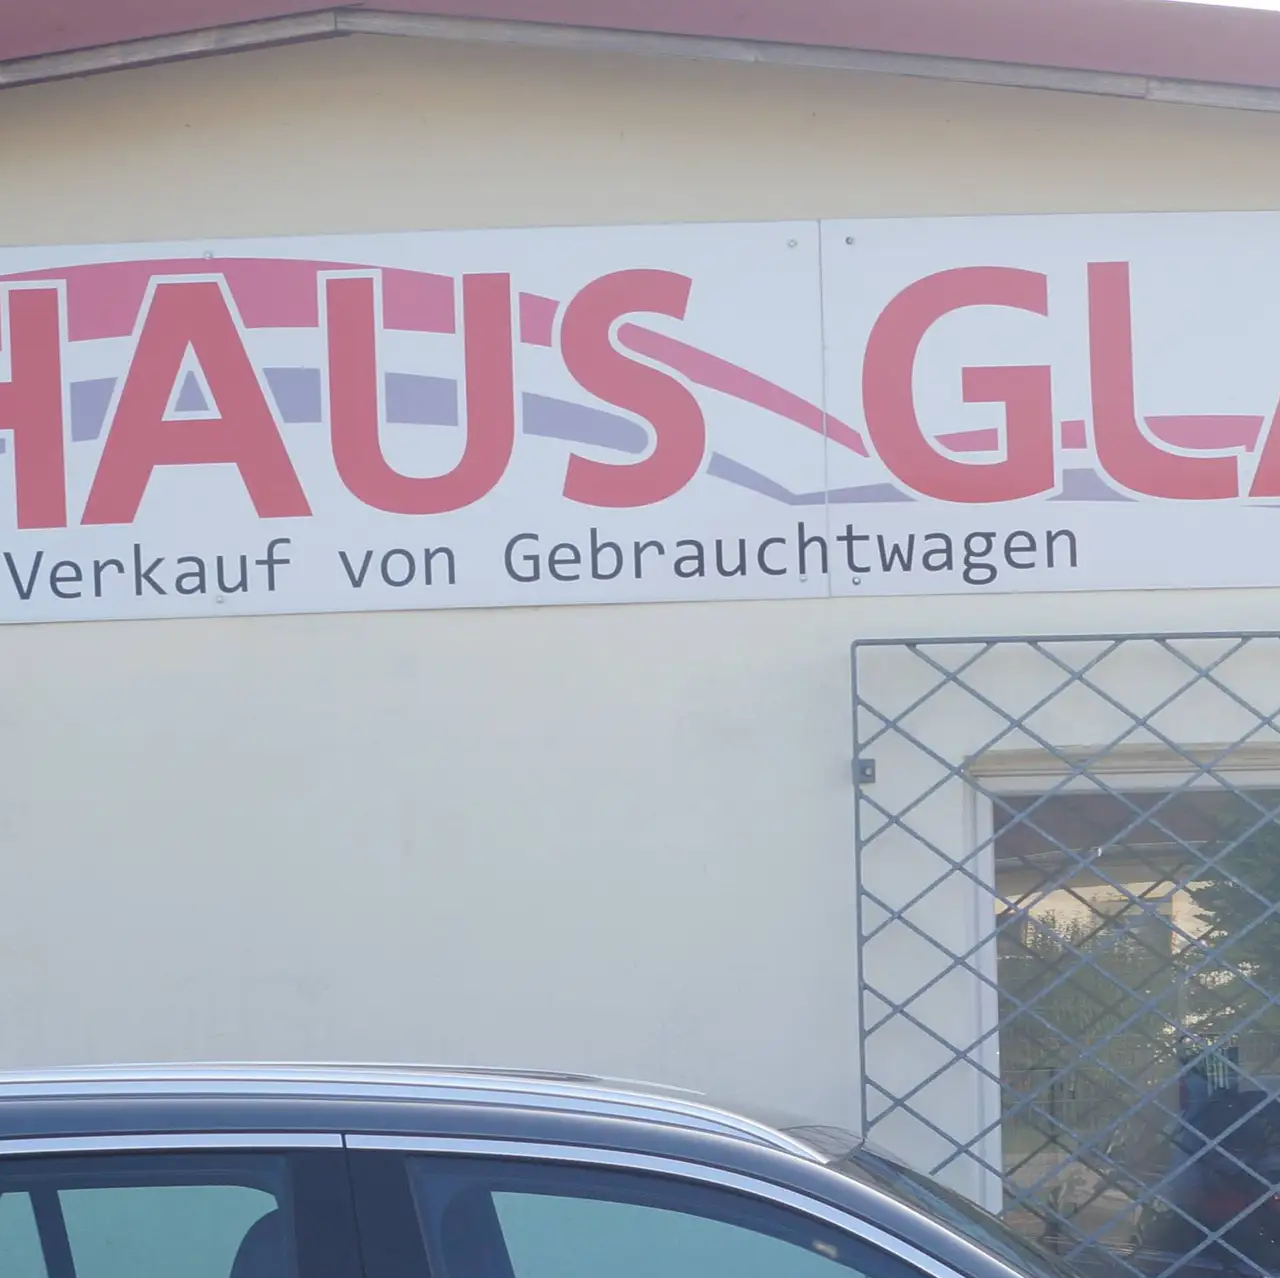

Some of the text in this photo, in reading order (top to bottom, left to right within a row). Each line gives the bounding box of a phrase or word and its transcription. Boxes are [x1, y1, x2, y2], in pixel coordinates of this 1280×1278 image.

[3, 537, 292, 601] Verkauf
[338, 544, 457, 589] von
[503, 521, 1079, 586] Gebrauchtwagen
